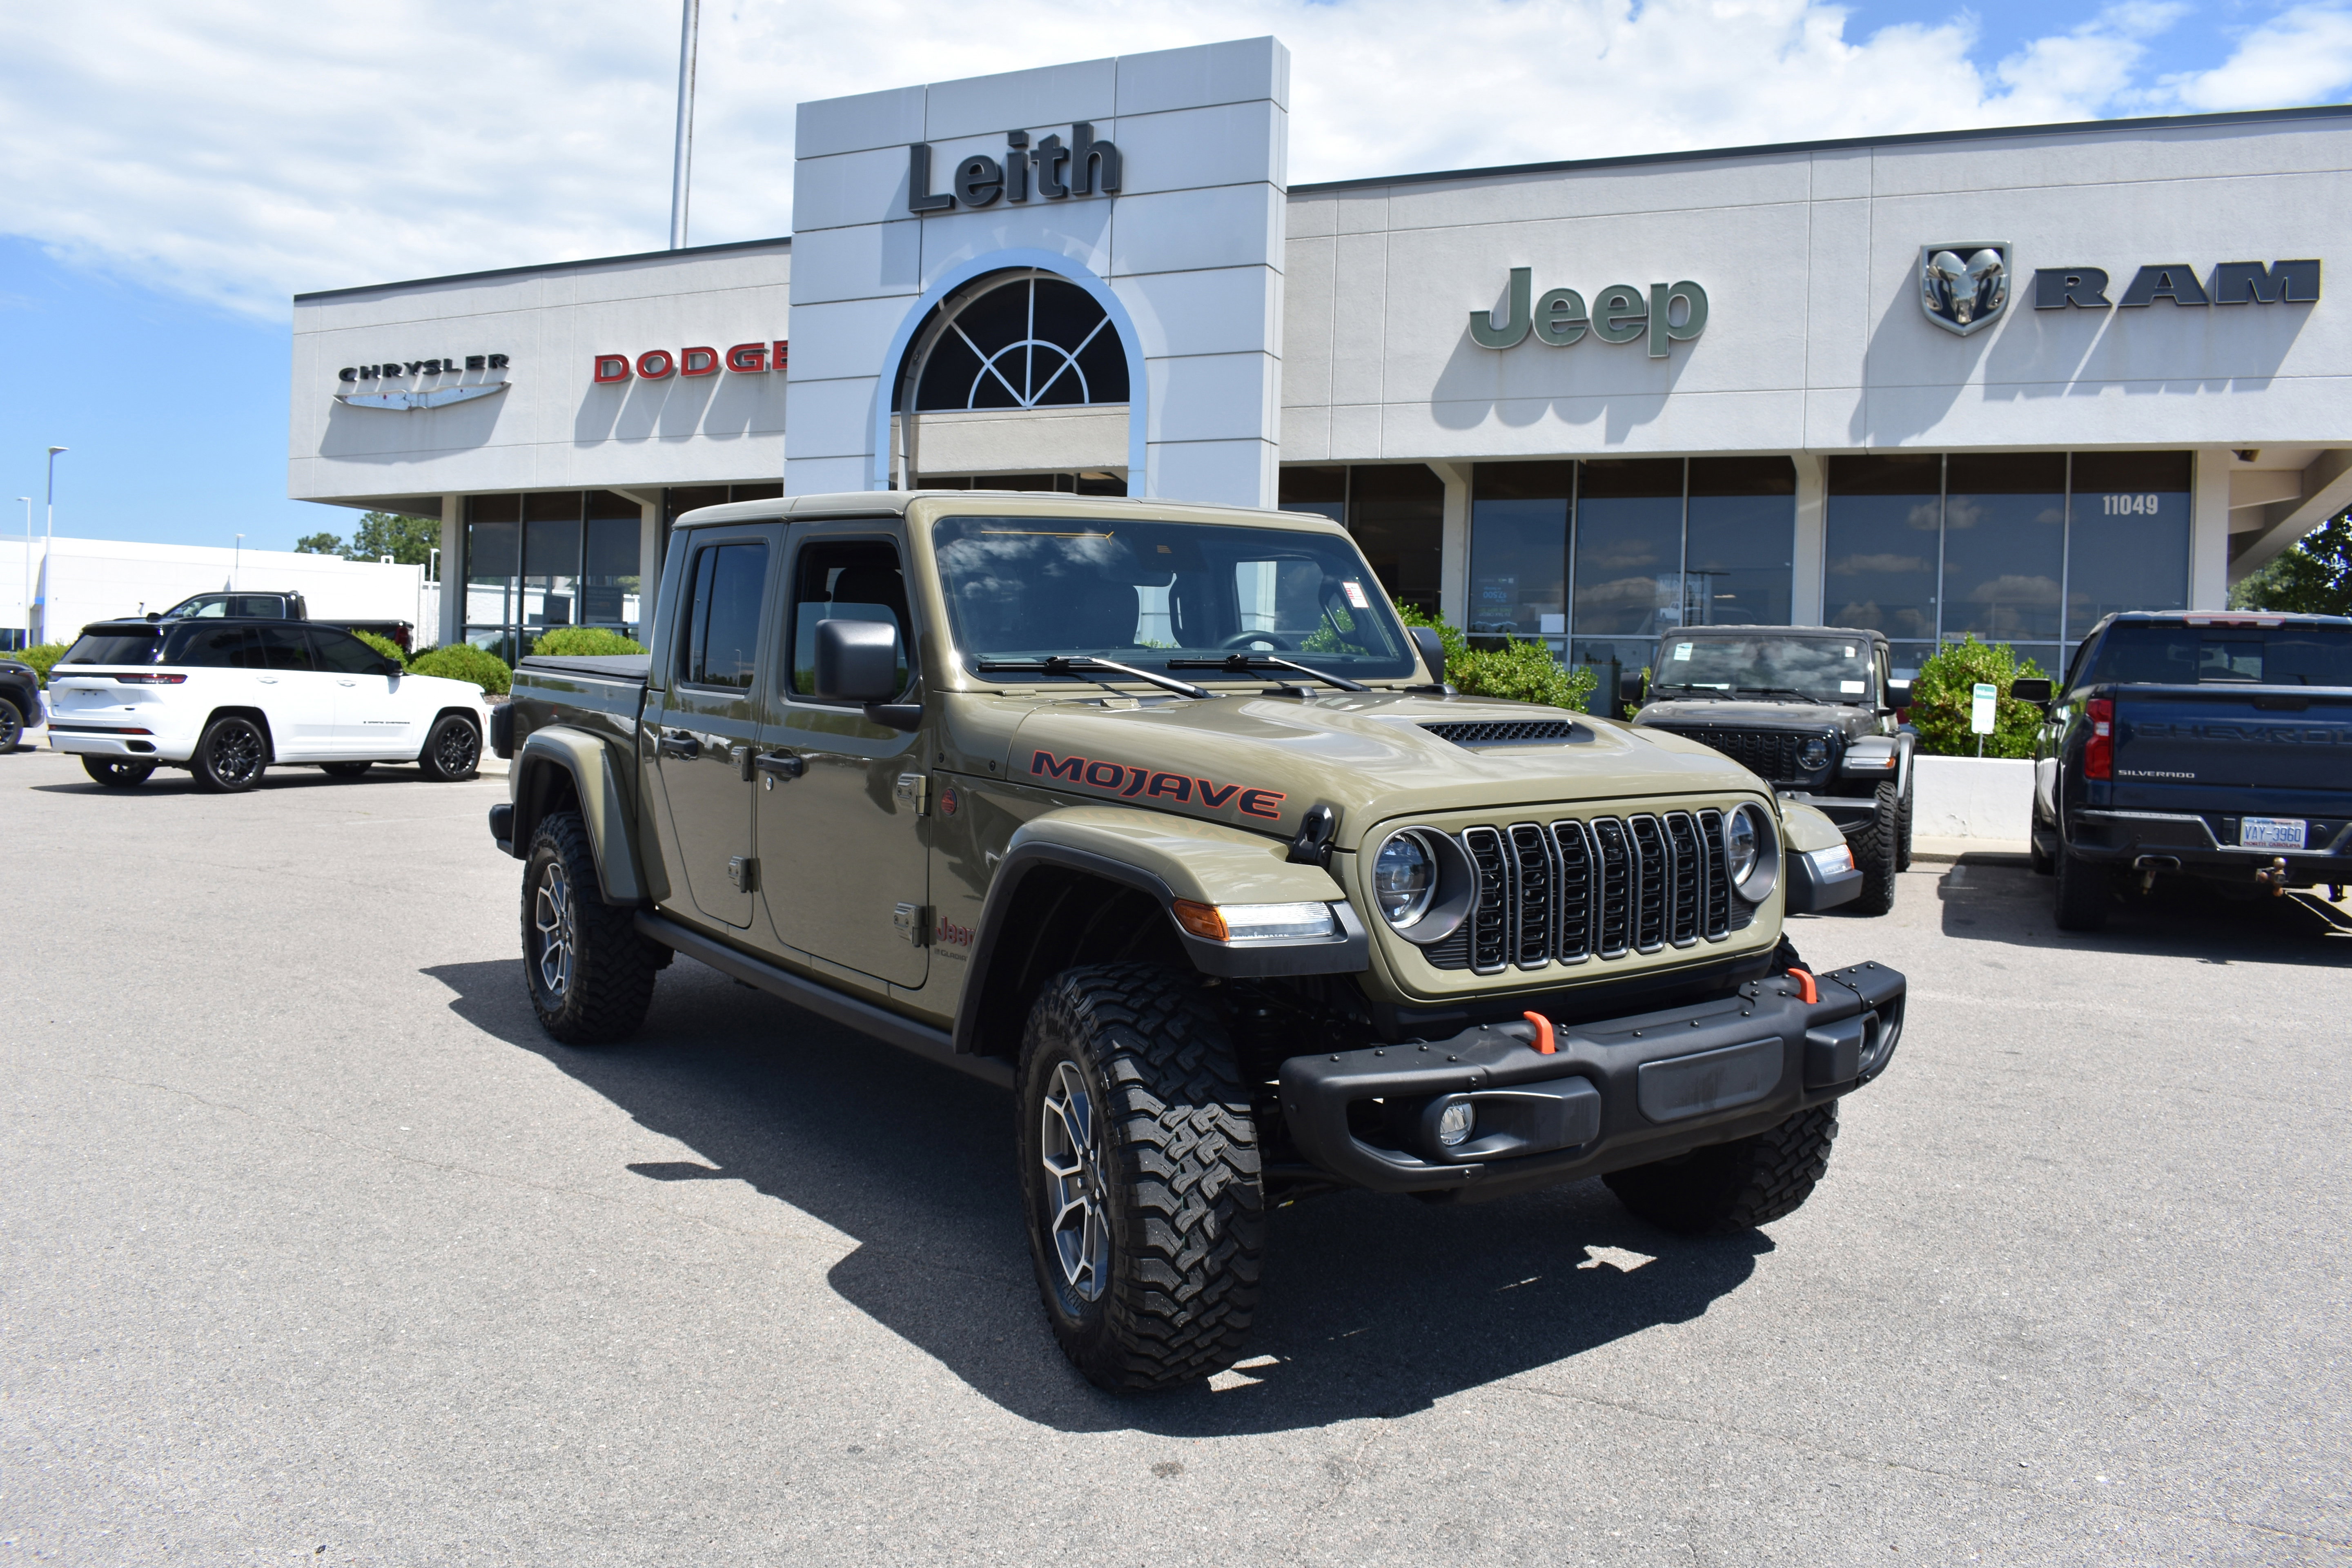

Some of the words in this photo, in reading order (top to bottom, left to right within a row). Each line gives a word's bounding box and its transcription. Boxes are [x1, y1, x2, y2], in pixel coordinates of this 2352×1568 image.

[909, 122, 1122, 213] Leith
[2034, 259, 2321, 310] RAM
[1469, 266, 1708, 358] Jeep
[339, 354, 509, 381] CHRYSLER
[2103, 494, 2158, 514] 11049
[1030, 750, 1287, 820] MOJAVE
[2118, 770, 2195, 778] SILVERADO
[2245, 825, 2301, 842] VAY-3960
[941, 949, 968, 962] GLADIA
